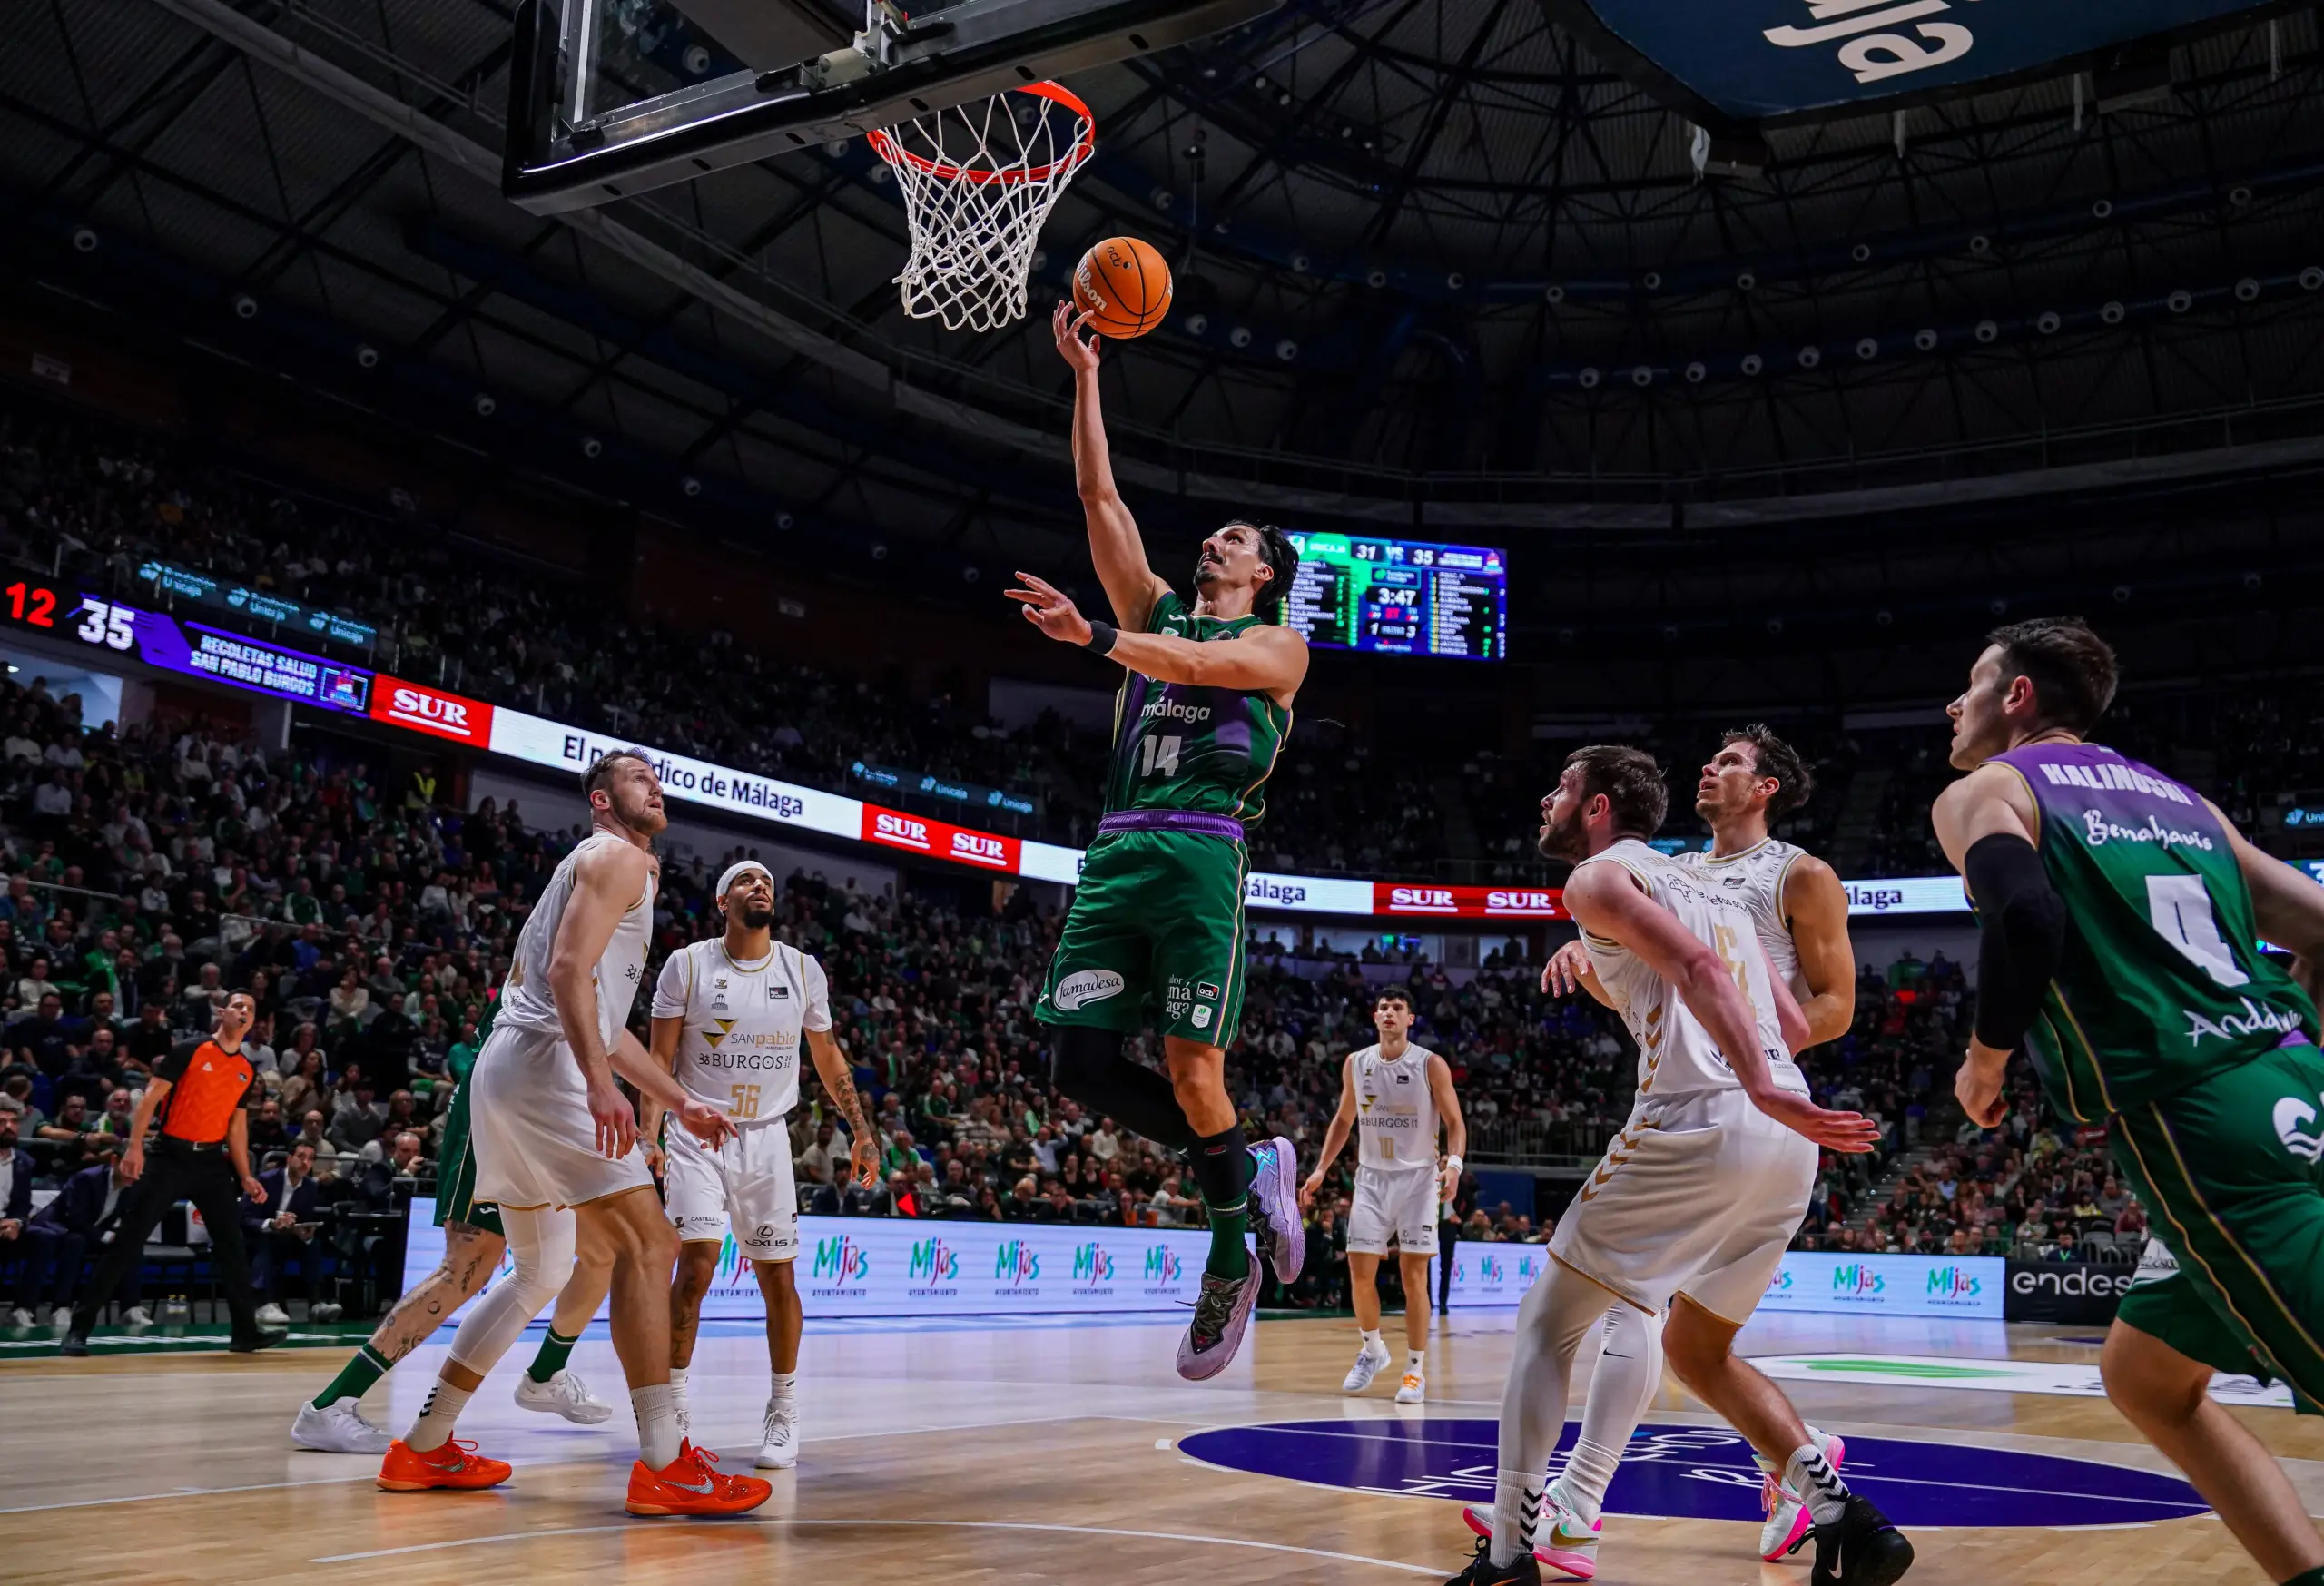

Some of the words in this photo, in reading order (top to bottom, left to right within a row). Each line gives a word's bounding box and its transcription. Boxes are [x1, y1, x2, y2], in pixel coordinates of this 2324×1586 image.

[1107, 246, 1122, 267] acb
[1356, 544, 1376, 560] 31
[1385, 546, 1404, 561] VS
[1413, 549, 1433, 566] 35
[5, 582, 56, 627] 12
[1378, 587, 1416, 606] 3:47
[78, 598, 135, 651] 35
[1370, 622, 1379, 635] 1
[1406, 625, 1416, 638] 3
[200, 635, 275, 669] RECOLETAS
[275, 655, 318, 680] SALUD
[190, 650, 220, 673] SAN
[220, 658, 262, 684] PABLO
[262, 668, 316, 697] BURGOS
[392, 688, 468, 726] SUR
[1141, 696, 1211, 724] málaga
[1141, 734, 1182, 777] 14
[563, 734, 586, 763] El
[701, 771, 727, 798] de
[731, 779, 803, 818] Málaga
[876, 813, 928, 842] SUR
[952, 832, 1005, 858] SUR
[1391, 888, 1454, 907] SUR
[1486, 892, 1551, 910] SUR
[2145, 873, 2250, 988] 4
[1059, 971, 1122, 1004] famadesa
[1199, 987, 1215, 998] acb
[713, 1053, 783, 1070] BURGOS
[727, 1084, 761, 1118] 56
[1366, 1118, 1410, 1128] BURGOS
[1378, 1136, 1394, 1159] 10
[744, 1238, 788, 1247] LEXUS
[812, 1235, 869, 1286] Mijas
[909, 1236, 959, 1286] Mijas
[995, 1240, 1040, 1286] Mijas
[1073, 1241, 1115, 1286] Mijas
[1145, 1244, 1182, 1286] Mijas
[1833, 1263, 1886, 1295] Mijas
[1926, 1266, 1982, 1299] Mijas
[2012, 1266, 2133, 1297] endes
